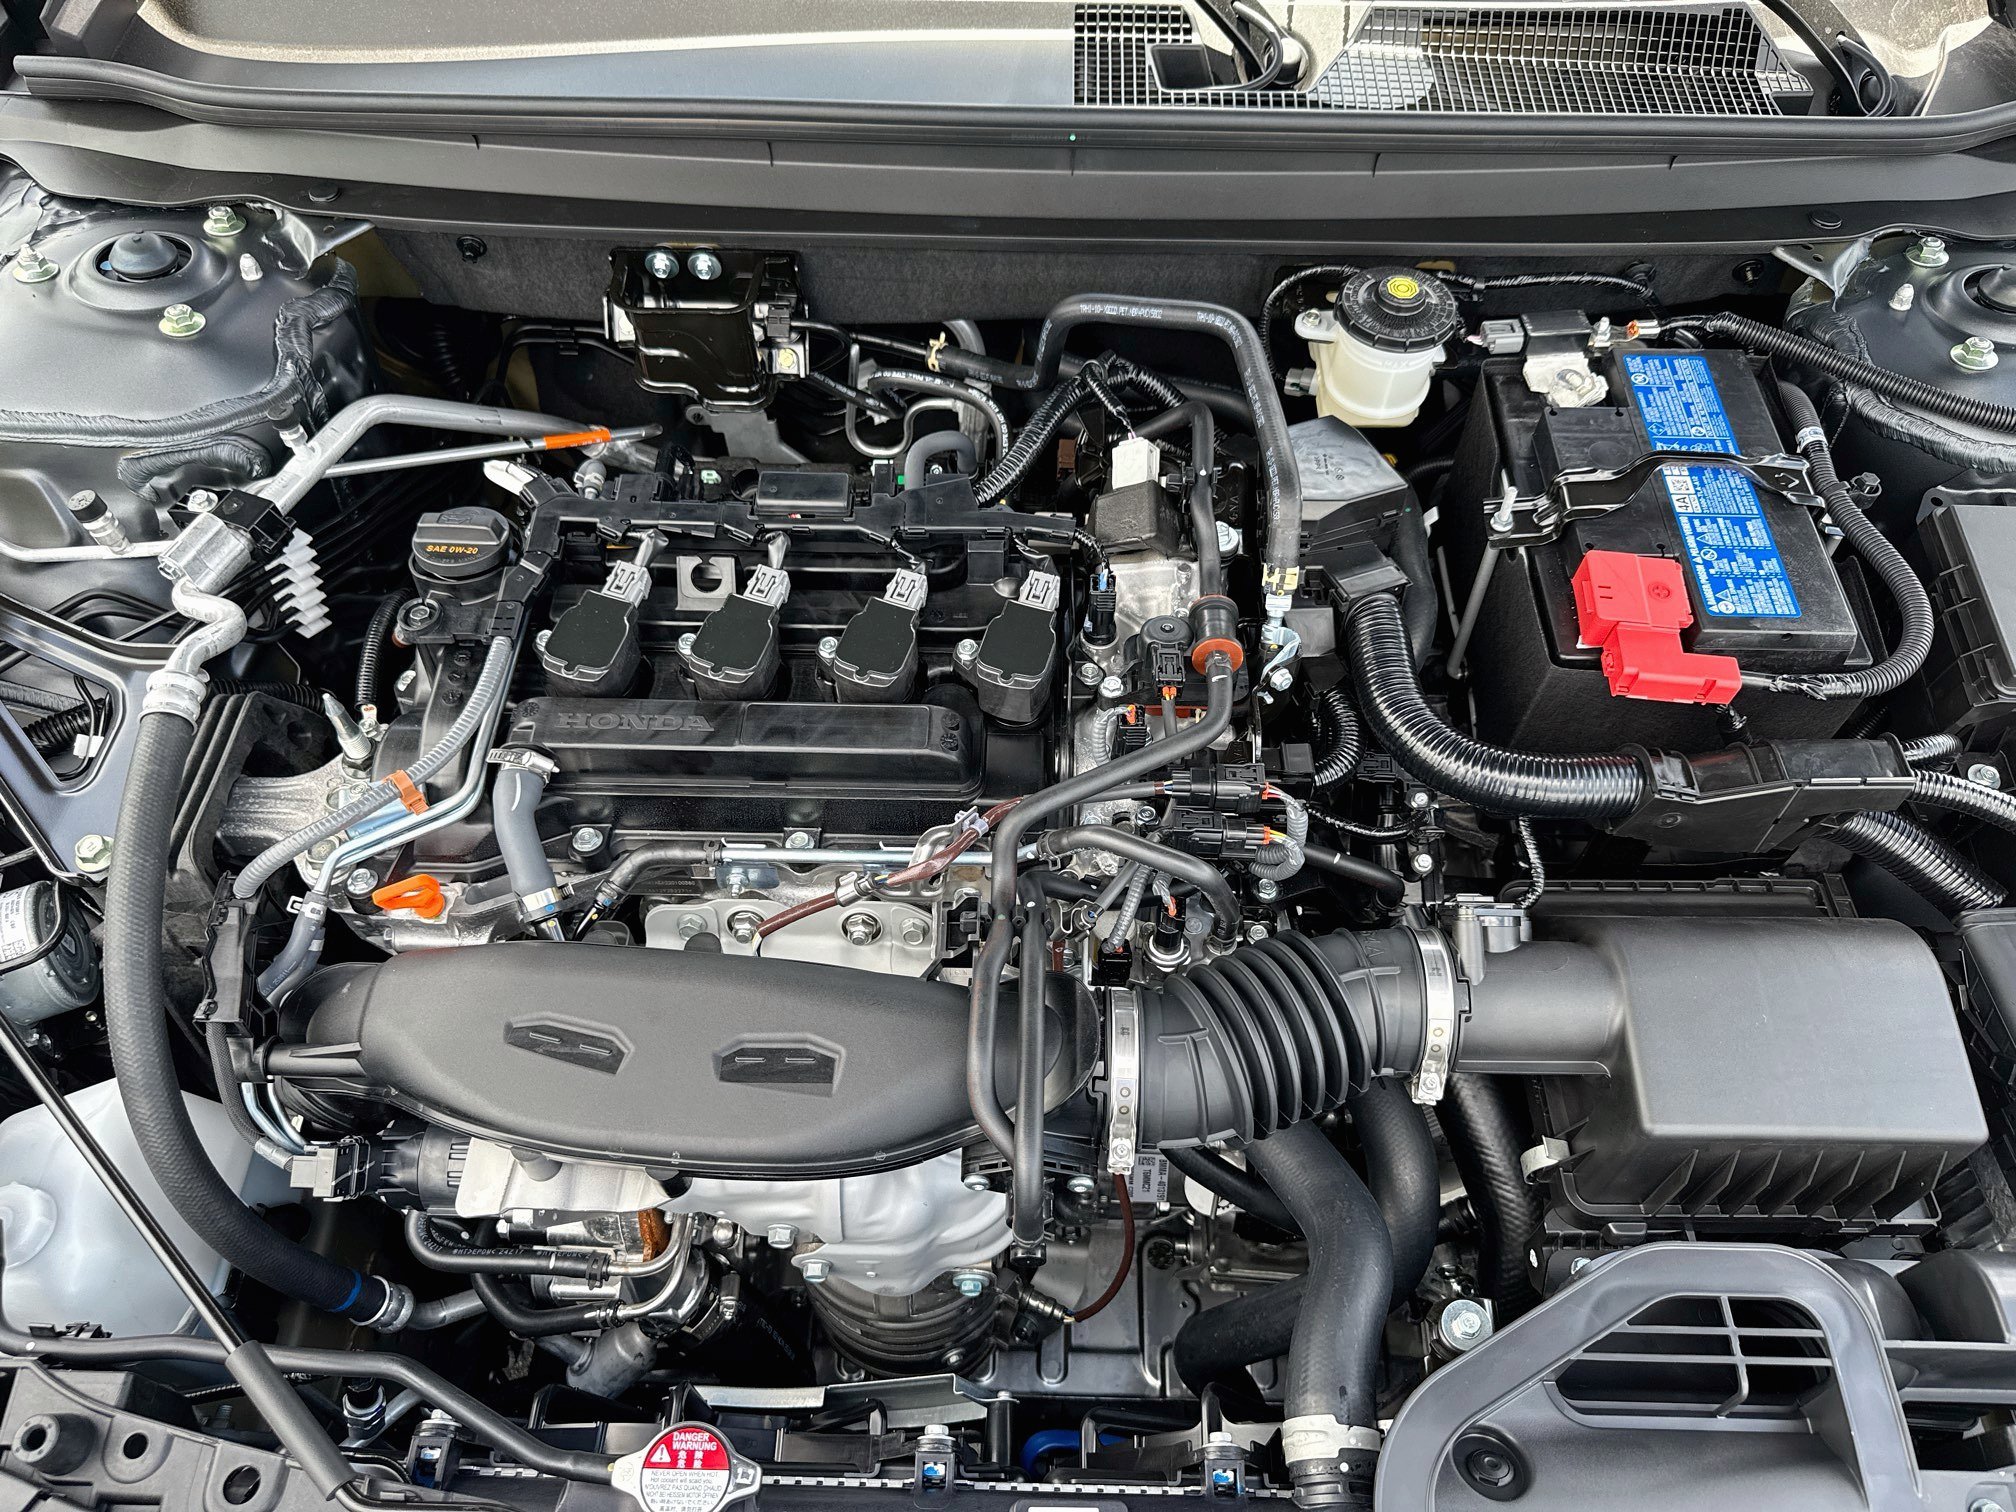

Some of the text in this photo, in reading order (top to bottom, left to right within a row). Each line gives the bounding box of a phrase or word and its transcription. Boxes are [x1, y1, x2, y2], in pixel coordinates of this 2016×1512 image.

[1674, 496, 1691, 510] 4A
[554, 712, 714, 732] HONDA
[673, 1432, 709, 1441] DANGER
[673, 1441, 717, 1450] WARNUNG
